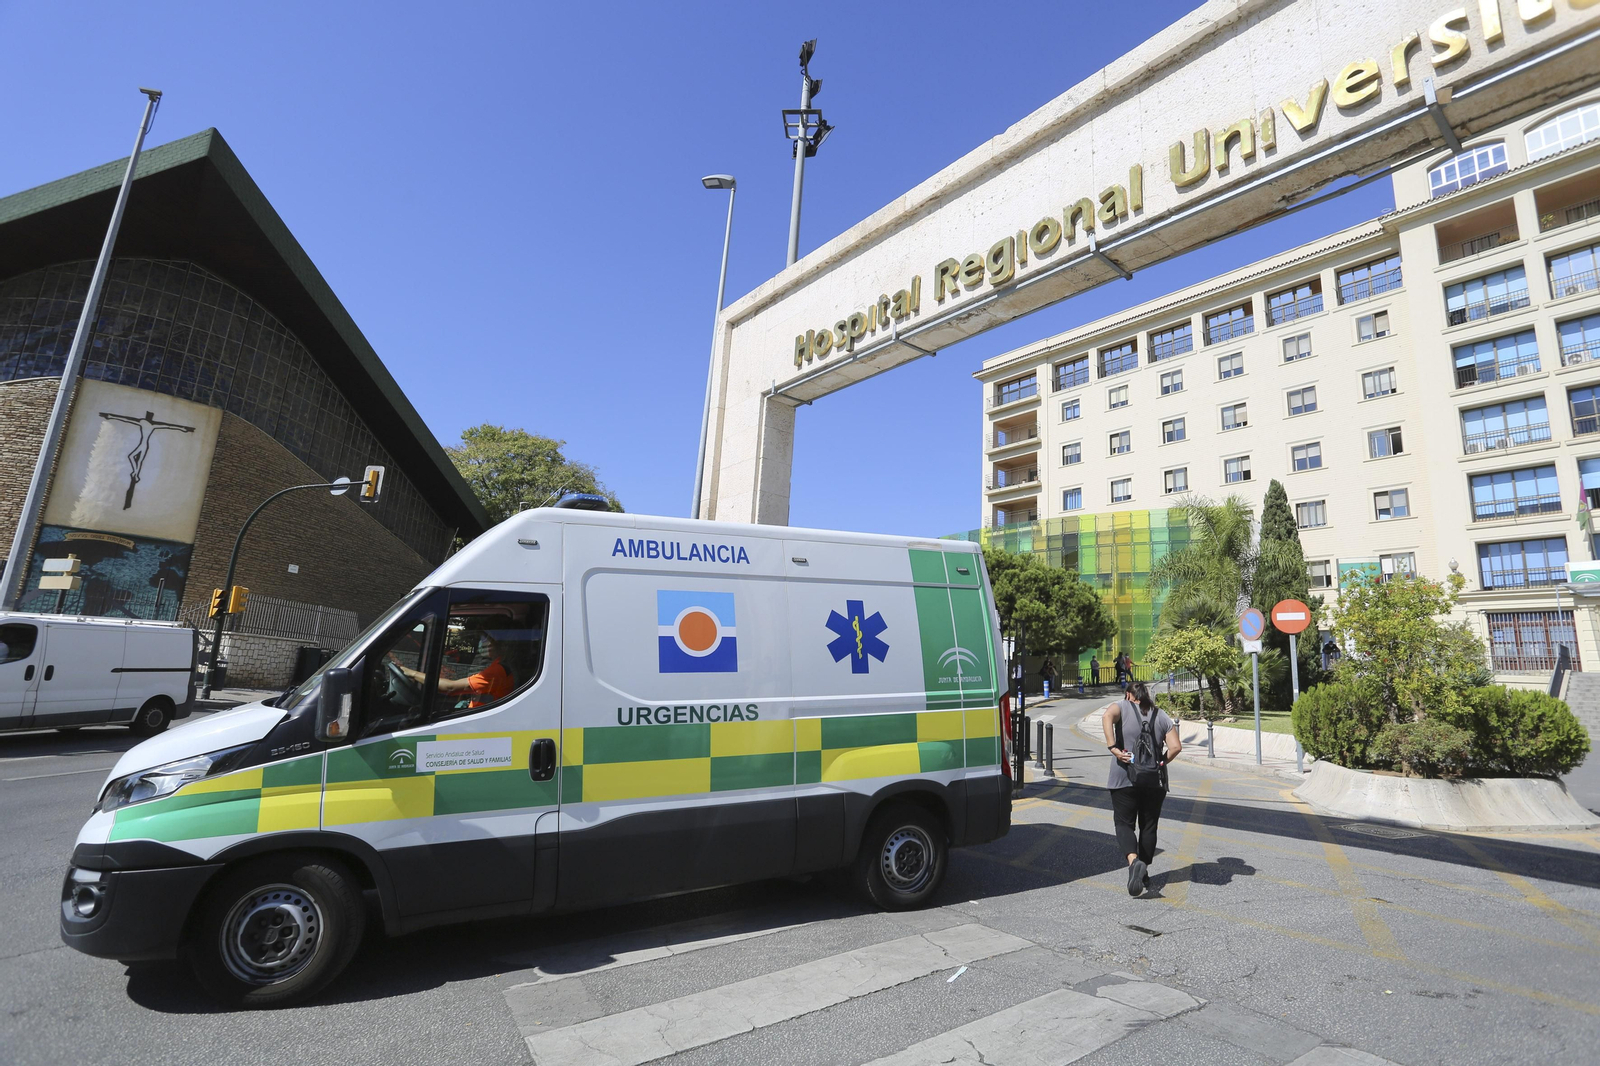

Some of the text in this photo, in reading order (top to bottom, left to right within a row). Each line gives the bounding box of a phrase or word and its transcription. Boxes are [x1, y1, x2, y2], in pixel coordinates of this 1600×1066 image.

[793, 0, 1600, 369] Hospital Regional Universi
[611, 537, 751, 565] AMBULANCIA
[617, 703, 759, 726] URGENCIAS
